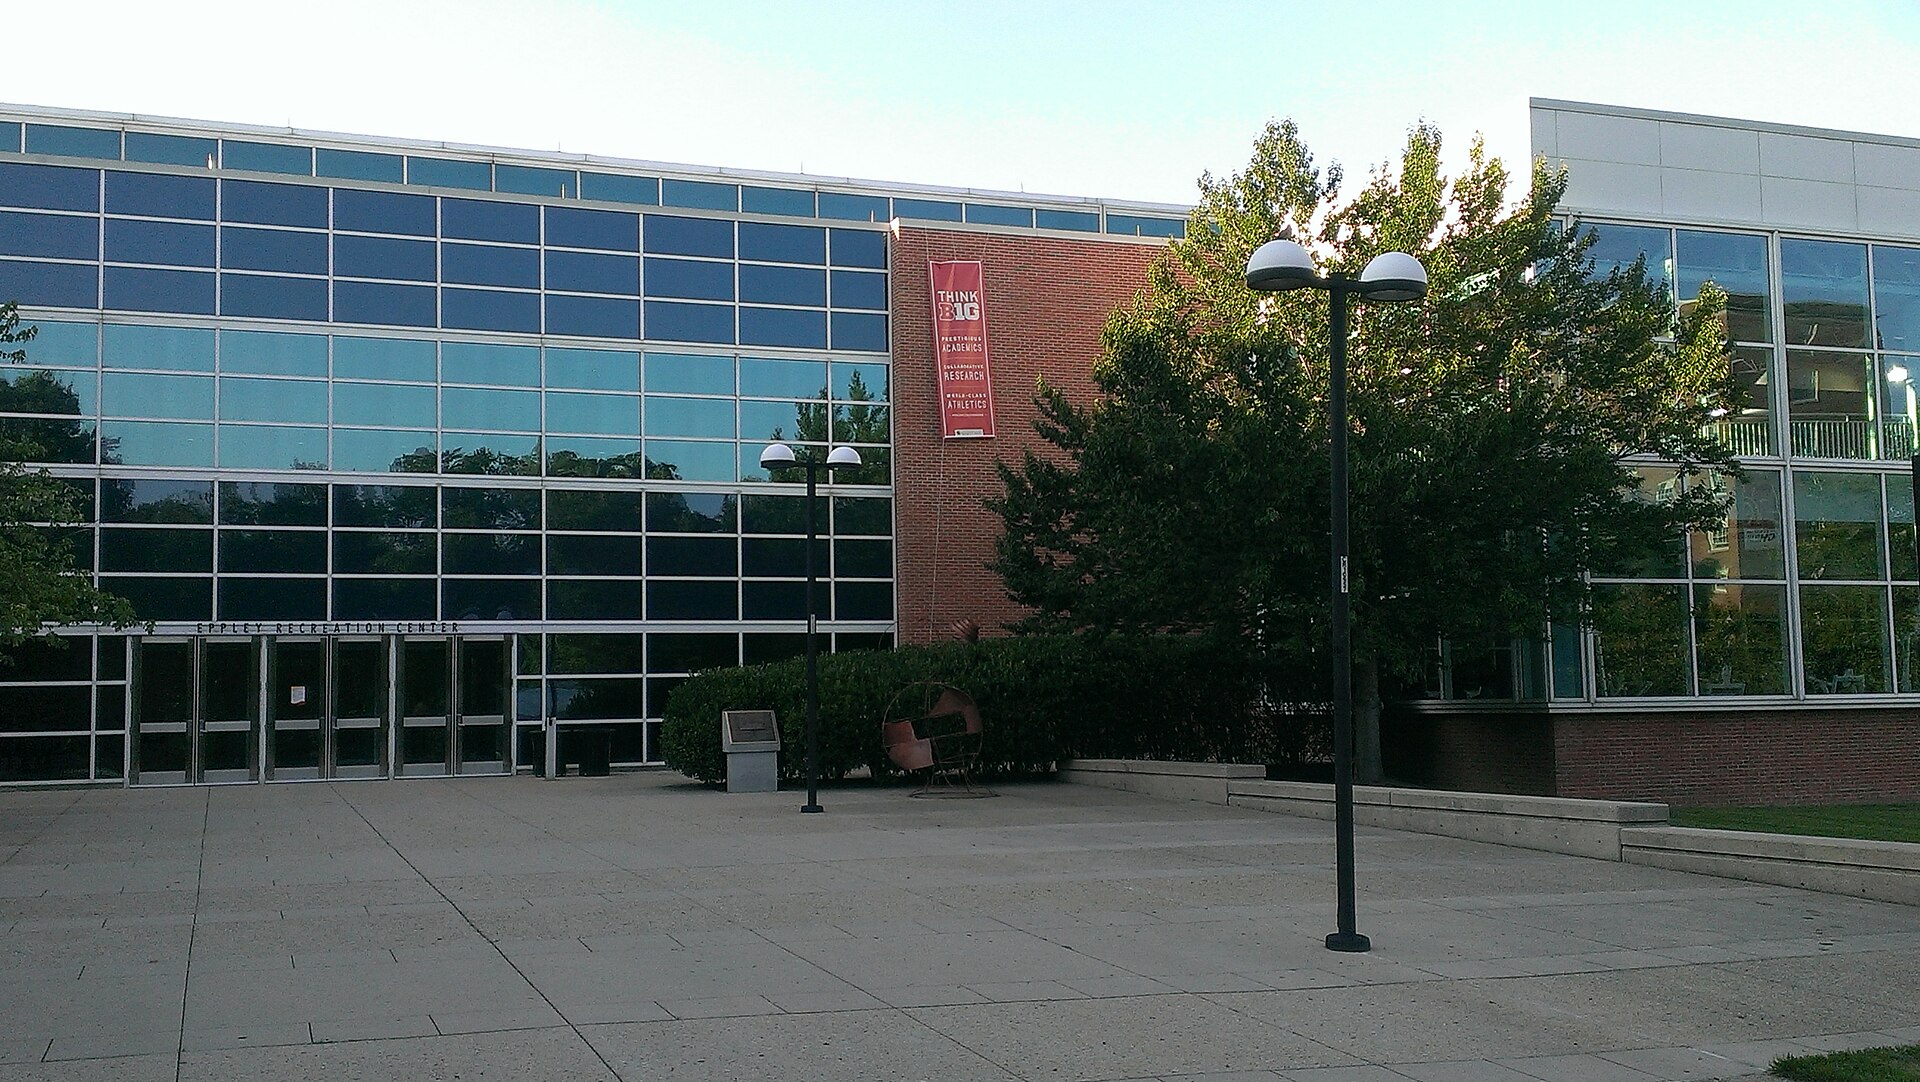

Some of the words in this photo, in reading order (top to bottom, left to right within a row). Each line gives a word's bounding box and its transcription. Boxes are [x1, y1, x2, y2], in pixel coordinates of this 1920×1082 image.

[937, 290, 979, 303] THINK
[942, 343, 983, 353] ACADEMICS
[944, 370, 985, 382] RESEARCH
[947, 400, 987, 410] ATHLETICS
[196, 623, 263, 634] EPPLEY
[275, 623, 385, 634] RECREATION
[396, 622, 459, 634] CENTER
